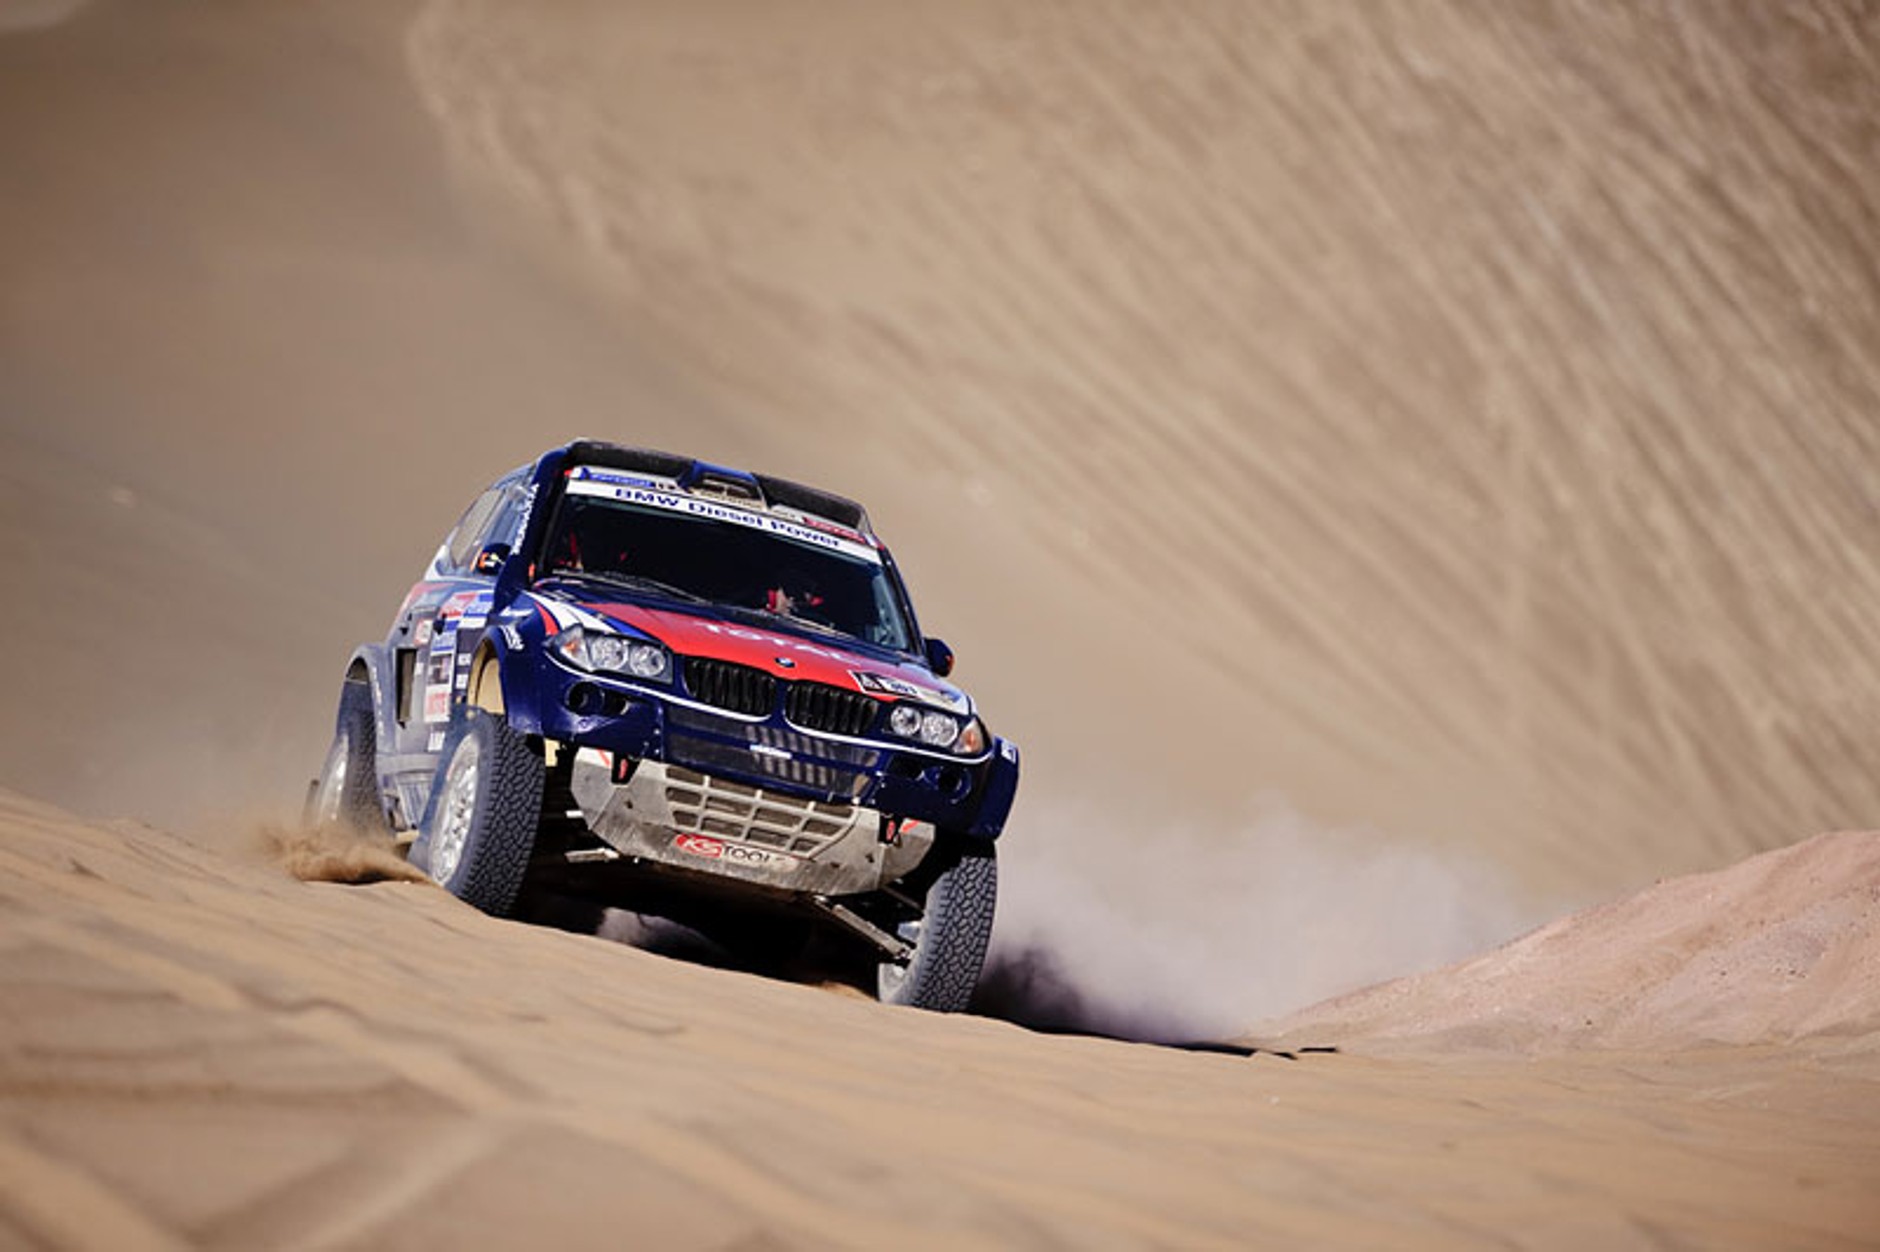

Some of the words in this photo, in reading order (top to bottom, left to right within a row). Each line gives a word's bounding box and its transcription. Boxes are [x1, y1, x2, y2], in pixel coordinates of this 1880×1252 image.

[615, 488, 678, 506] BMW
[688, 502, 763, 528] Diesel
[770, 519, 840, 547] Power
